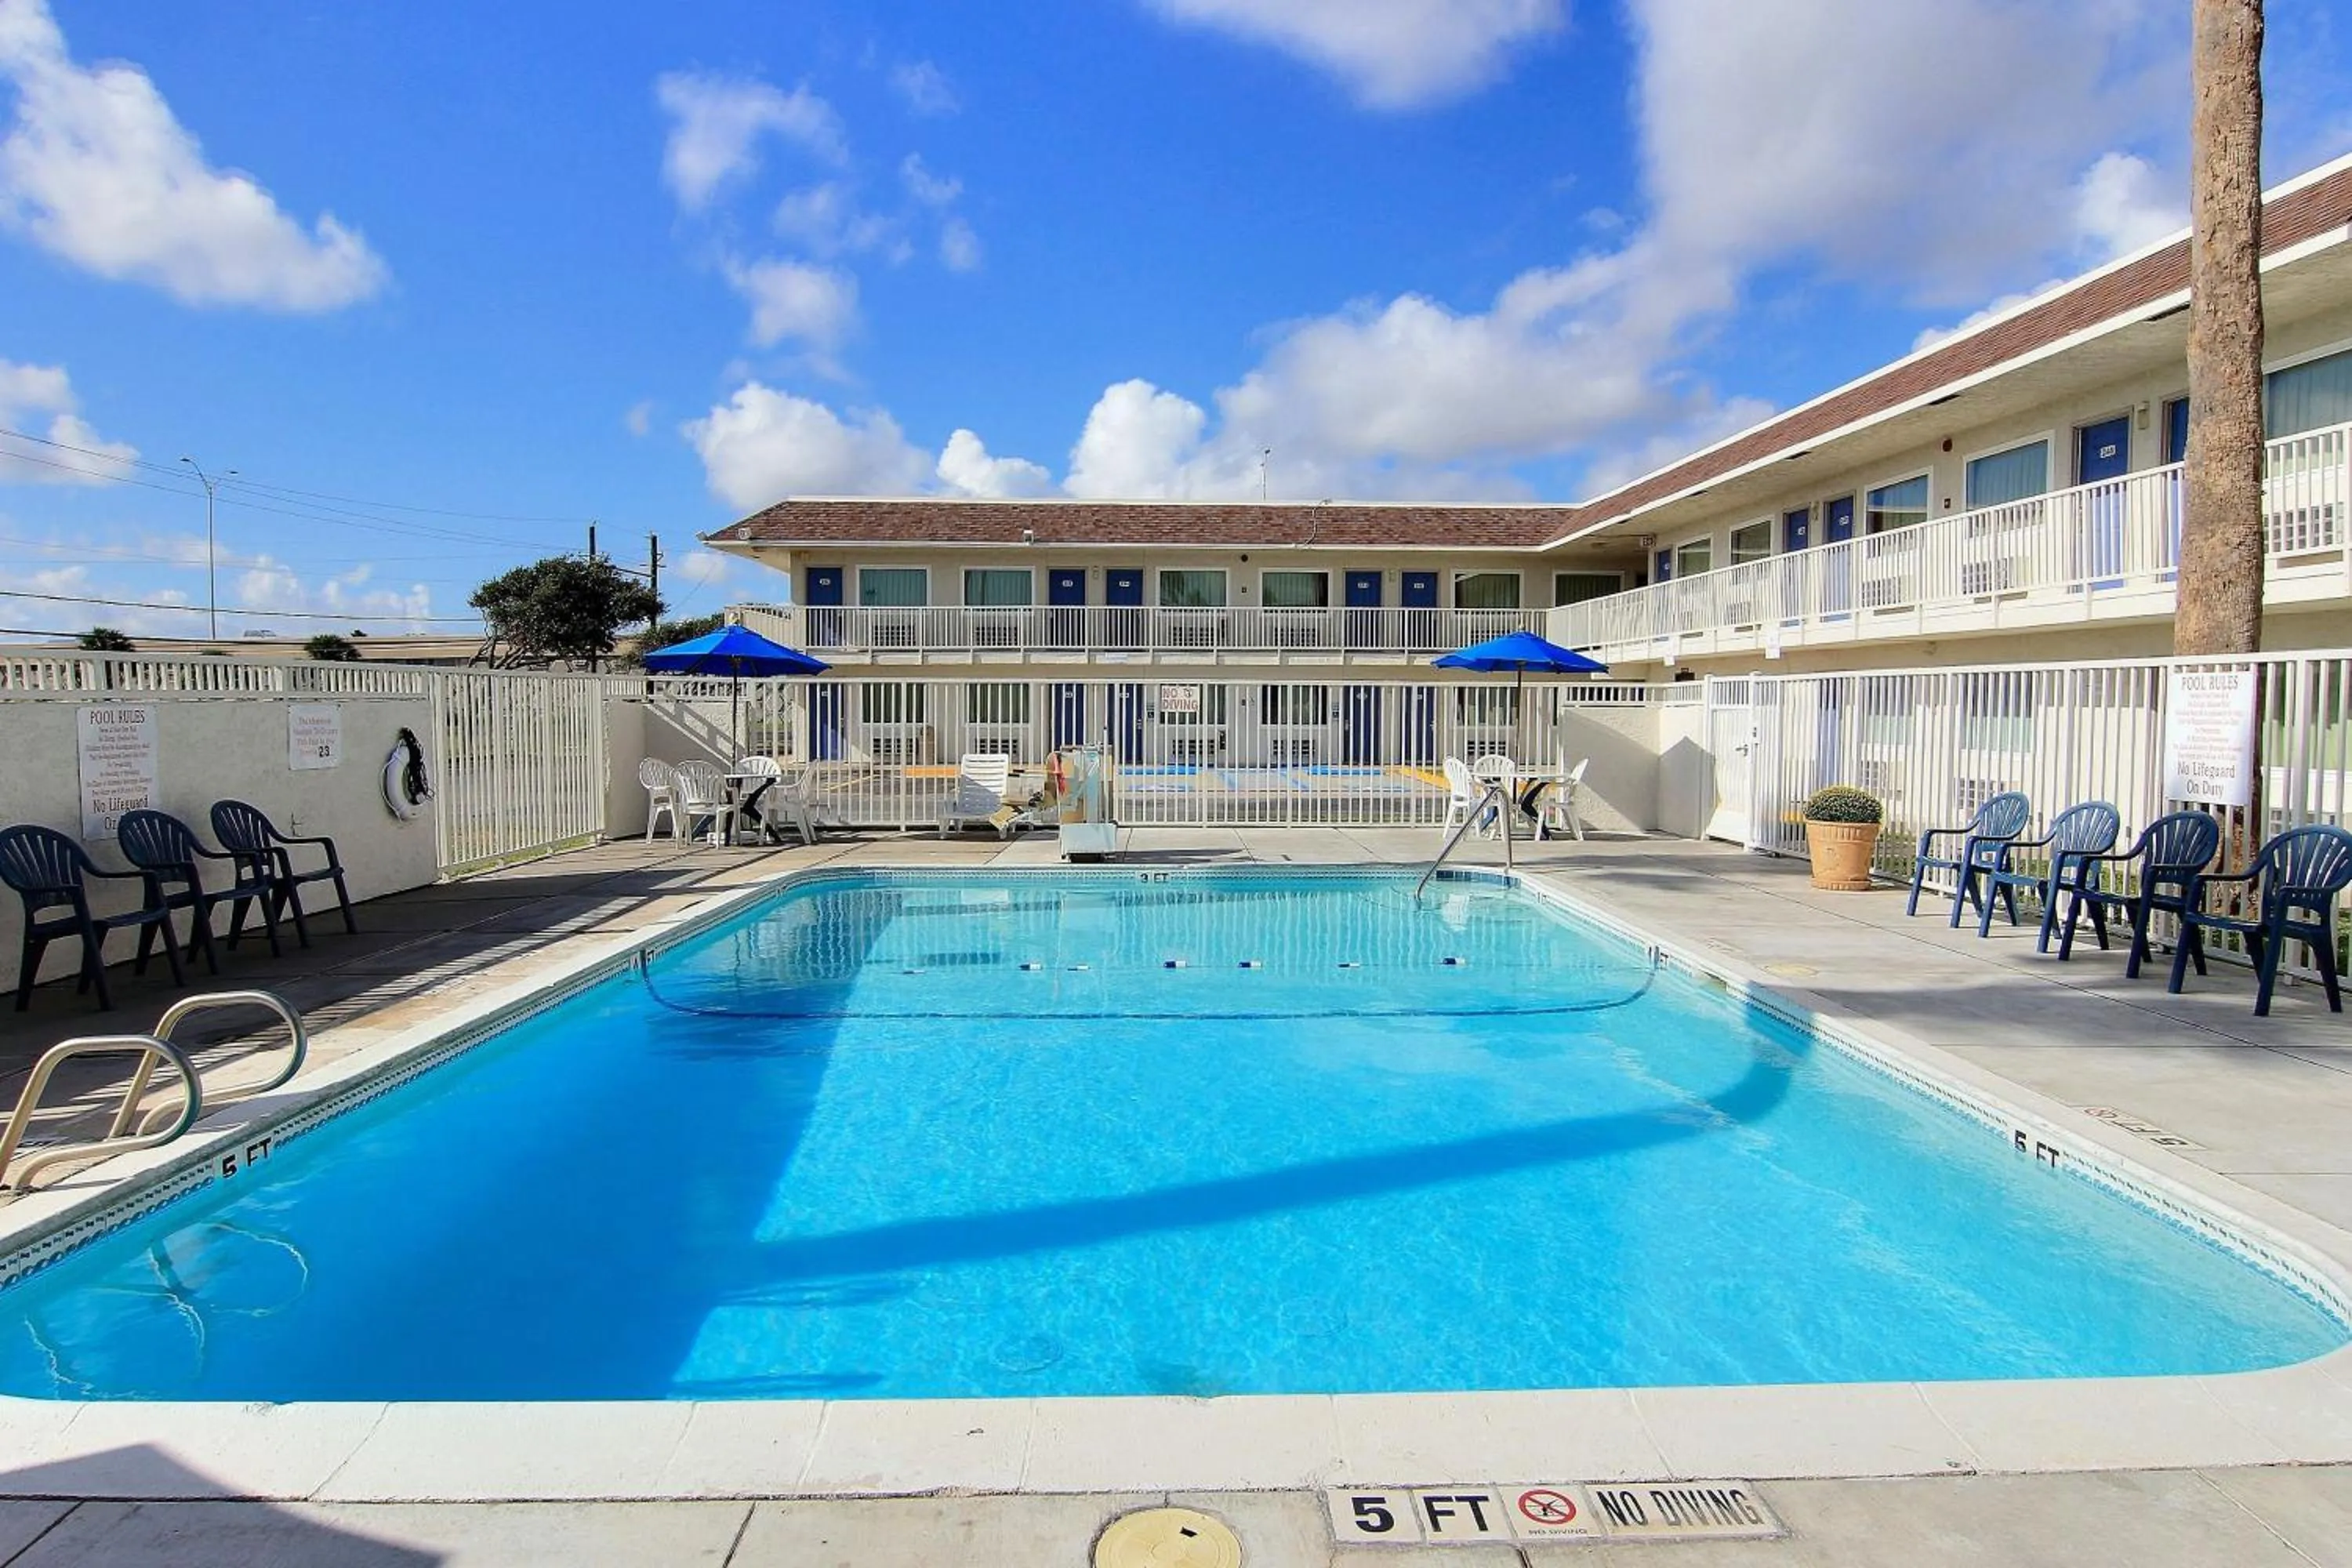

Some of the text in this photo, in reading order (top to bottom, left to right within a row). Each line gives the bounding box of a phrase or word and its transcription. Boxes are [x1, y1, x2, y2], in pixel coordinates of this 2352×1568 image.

[2181, 675, 2239, 691] POOL RULES
[1163, 688, 1178, 699] NO
[1163, 699, 1198, 710] DIVING
[90, 709, 145, 725] POOL RULES
[318, 746, 330, 757] 23
[2177, 762, 2235, 779] No Lifeguard
[2187, 779, 2224, 799] On Duty
[93, 800, 106, 813] No
[1140, 873, 1149, 884] 3
[222, 1136, 272, 1178] 5 FT
[2015, 1130, 2060, 1168] 5 FT
[1351, 1495, 1491, 1534] 5 FT
[1596, 1488, 1766, 1527] NO DIVING
